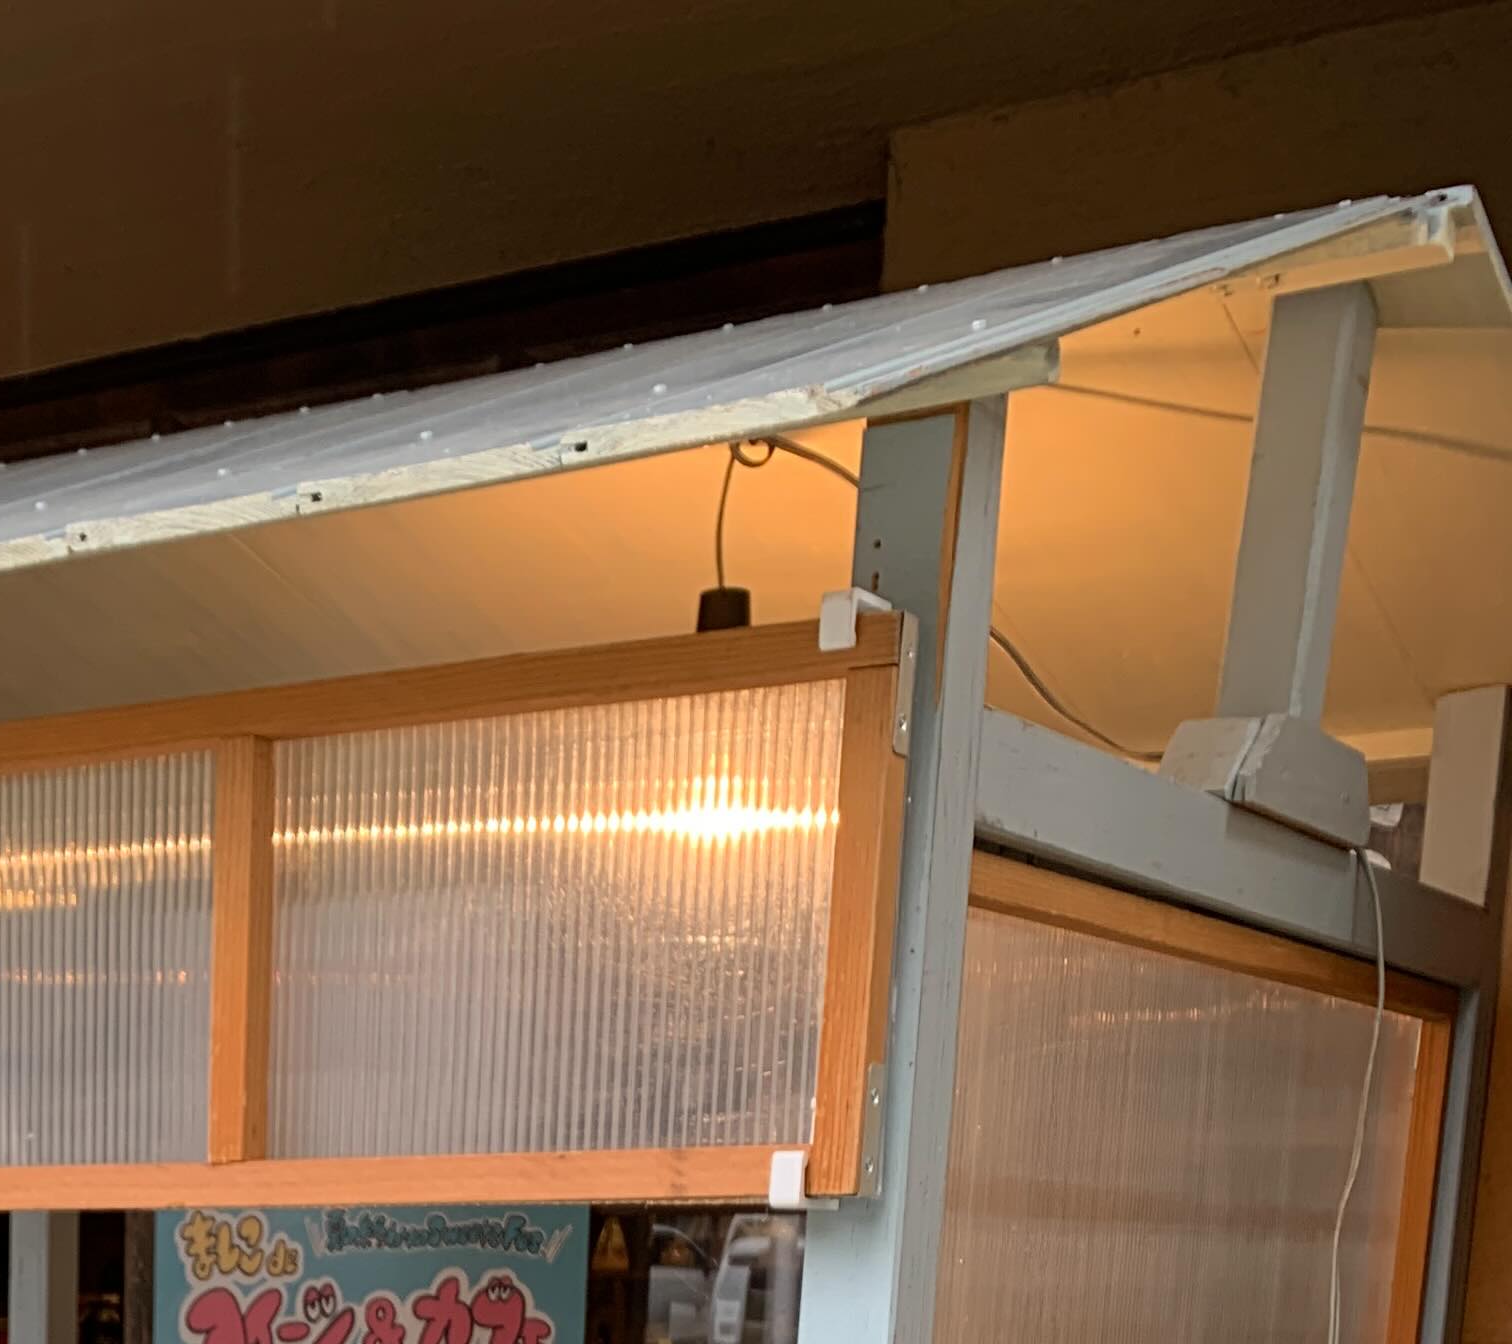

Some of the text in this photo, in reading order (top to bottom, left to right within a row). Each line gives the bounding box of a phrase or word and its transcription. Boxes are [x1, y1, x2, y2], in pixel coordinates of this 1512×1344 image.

[179, 1210, 264, 1281] ましこ
[266, 1238, 298, 1276] de
